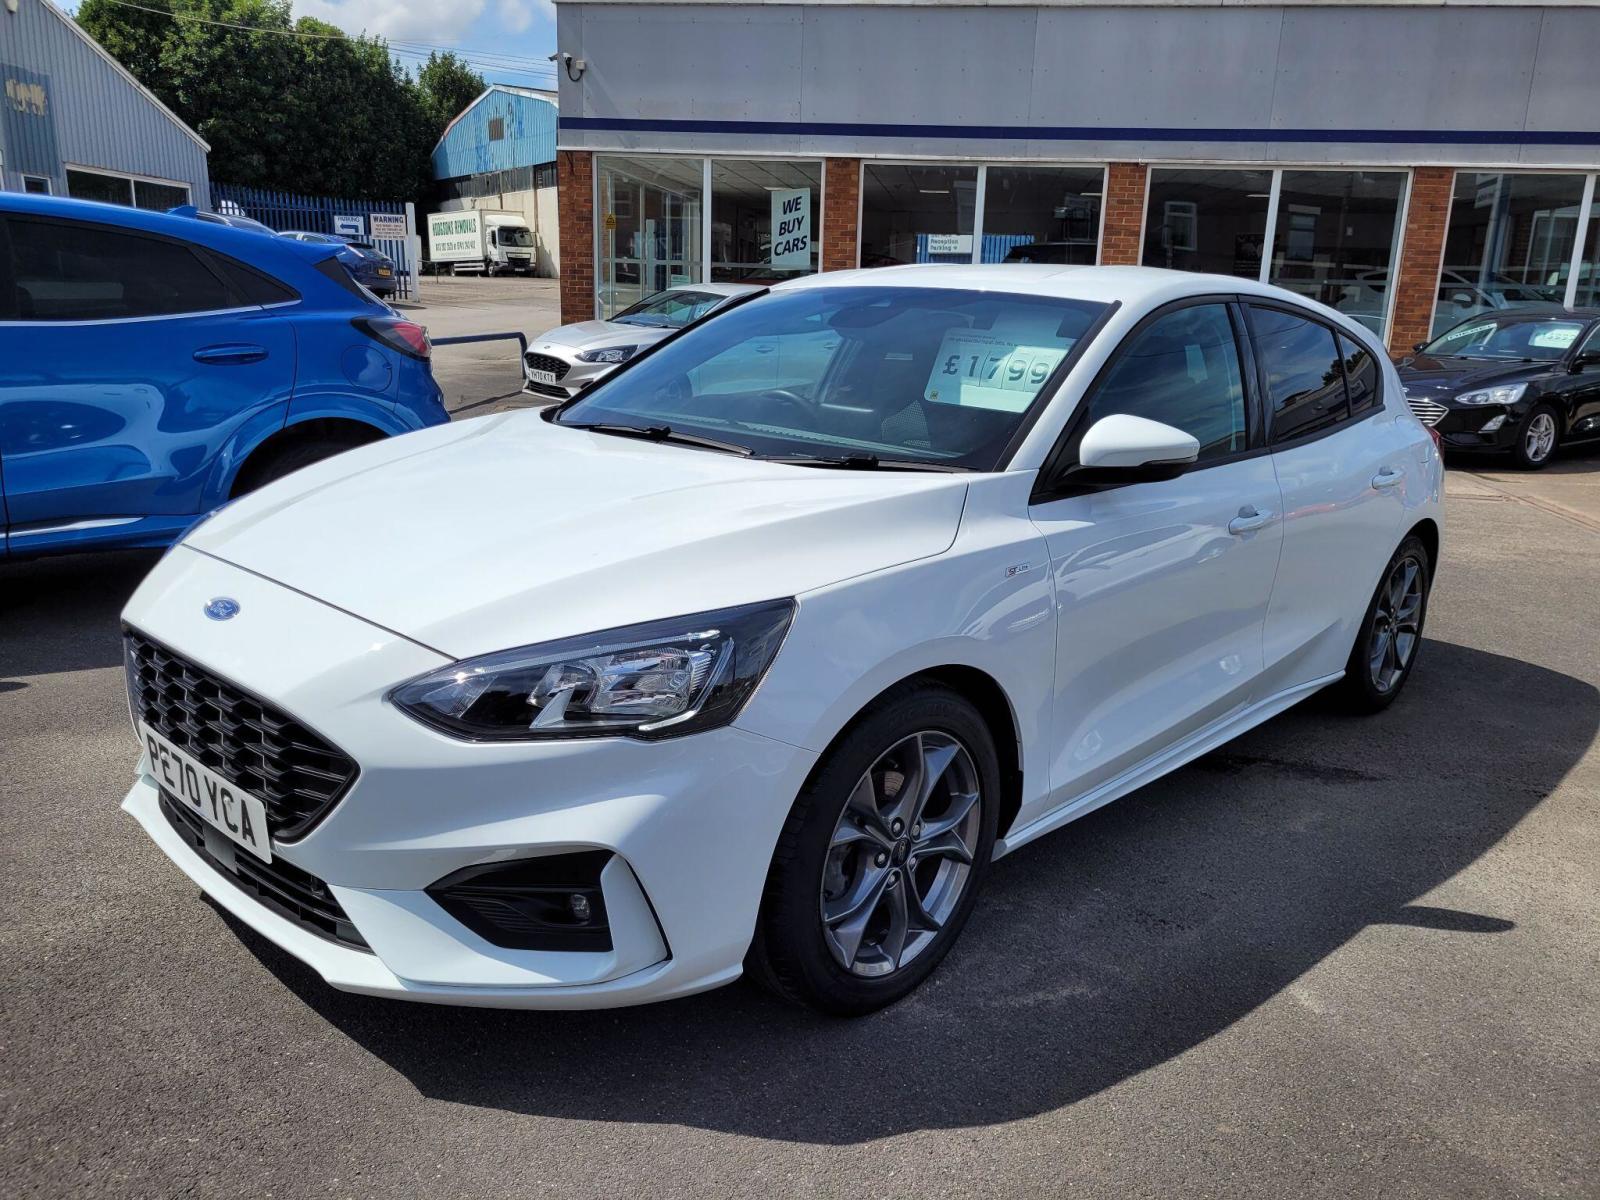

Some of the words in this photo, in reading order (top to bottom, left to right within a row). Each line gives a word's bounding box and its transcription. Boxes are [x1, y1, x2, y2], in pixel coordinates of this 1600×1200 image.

[782, 195, 802, 214] WE
[372, 215, 404, 223] WARNING
[454, 218, 477, 235] REMOVALS
[778, 216, 804, 236] BUY
[774, 235, 807, 256] CARS
[930, 238, 959, 246] Reception
[146, 732, 202, 808] PE70
[204, 774, 257, 849] YCA
